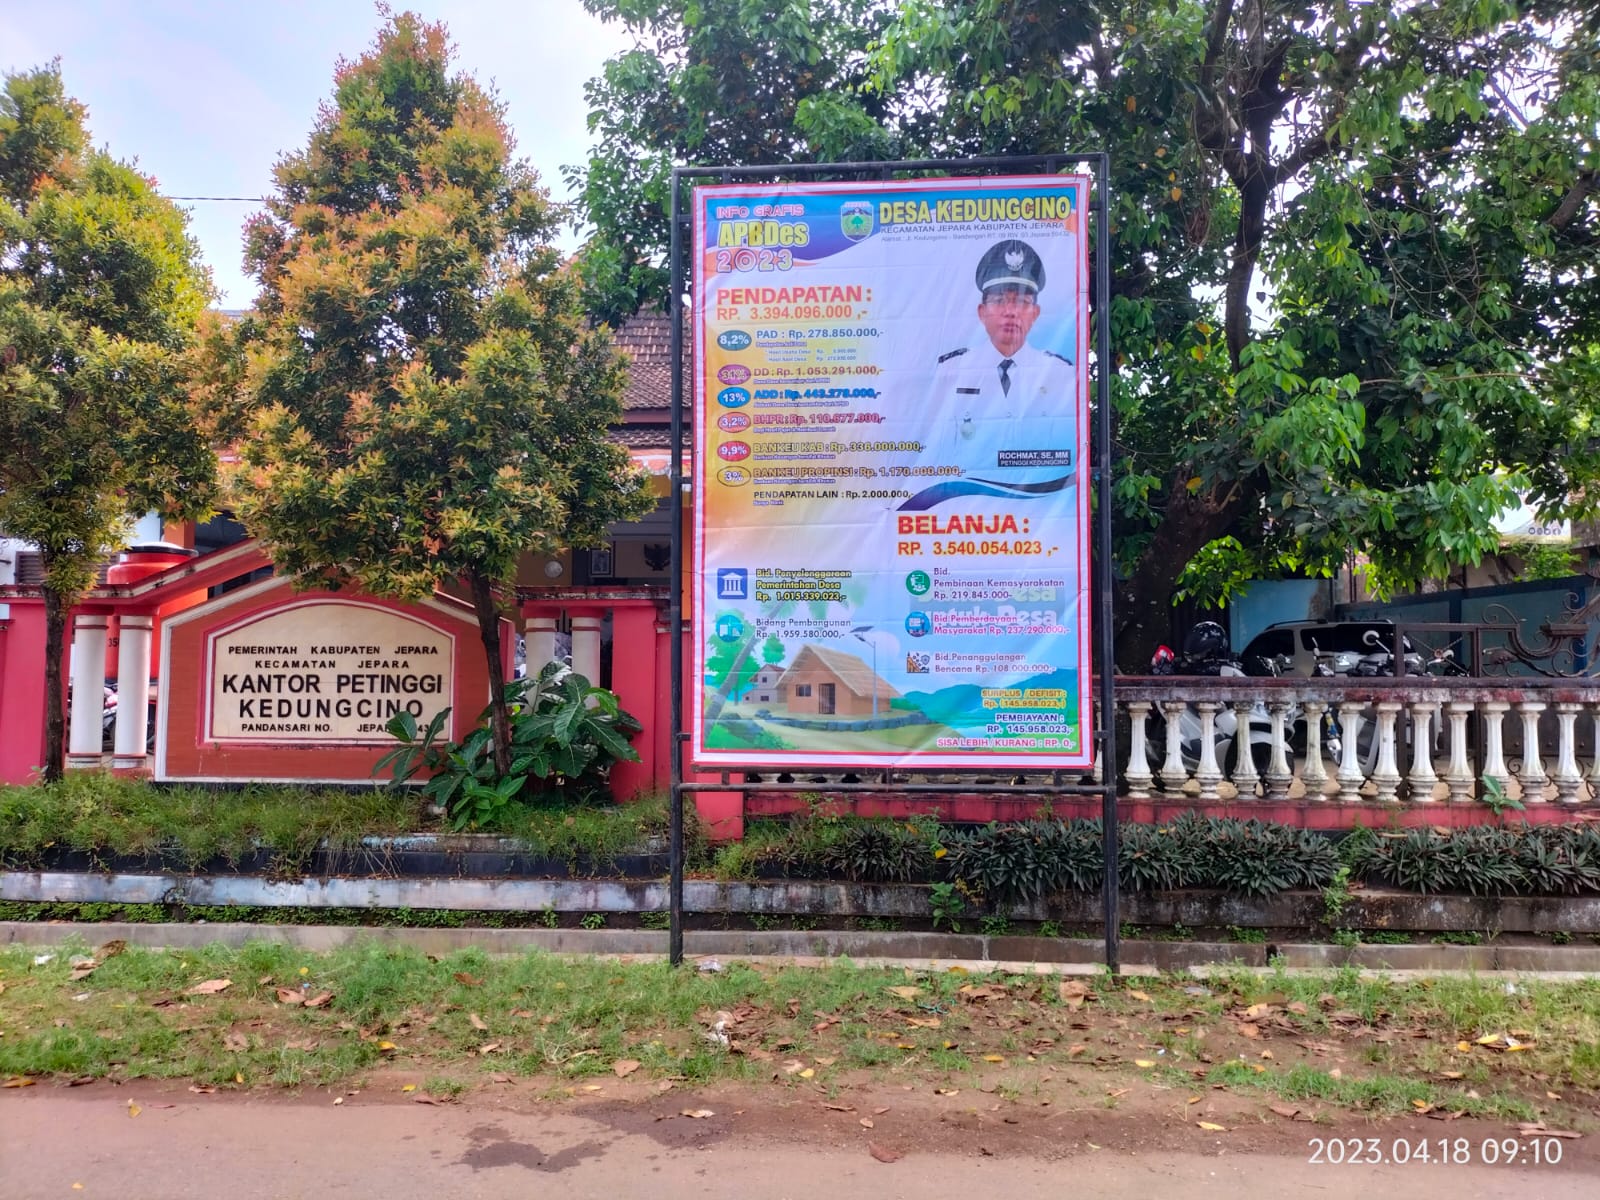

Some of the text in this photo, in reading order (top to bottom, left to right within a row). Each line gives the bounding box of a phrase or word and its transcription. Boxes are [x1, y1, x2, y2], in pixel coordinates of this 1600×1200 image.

[716, 205, 804, 218] INFO GRAFIS
[879, 196, 1071, 224] DESA KEDUNGCINO
[975, 223, 1027, 231] KABUPATEN
[718, 221, 809, 247] APBDes
[717, 249, 793, 272] 2023
[717, 308, 740, 320] RP.
[757, 330, 778, 338] PAD
[719, 335, 748, 345] 8,2%
[754, 368, 769, 376] DD
[722, 393, 745, 402] 13%
[754, 390, 778, 399] ADD
[721, 417, 746, 426] 3,2%
[753, 414, 784, 424] BHPR
[721, 445, 747, 455] 9,9%
[753, 443, 800, 452] BANKEU
[753, 468, 799, 478] BANKEU
[754, 491, 814, 499] PENDAPATAN
[898, 542, 923, 555] RP.
[933, 541, 1041, 555] 3.540.054.023
[818, 580, 841, 589] Desa
[987, 579, 1064, 588] Kemasyarakatan
[756, 619, 851, 627] Bidang Pembangunan
[934, 627, 986, 635] Masyarakat
[228, 646, 438, 654] PEMERINTAH KABUPATEN JEPARA
[255, 660, 409, 668] KECAMATAN JEPARA
[222, 674, 442, 693] KANTOR PETINGGI
[239, 699, 422, 718] KEDUNGCINO
[996, 714, 1058, 722] PEMBIAYAAN
[242, 724, 310, 732] PANDANSARI
[315, 724, 332, 732] NO.
[937, 739, 960, 747] SISA
[995, 739, 1035, 747] KURANG
